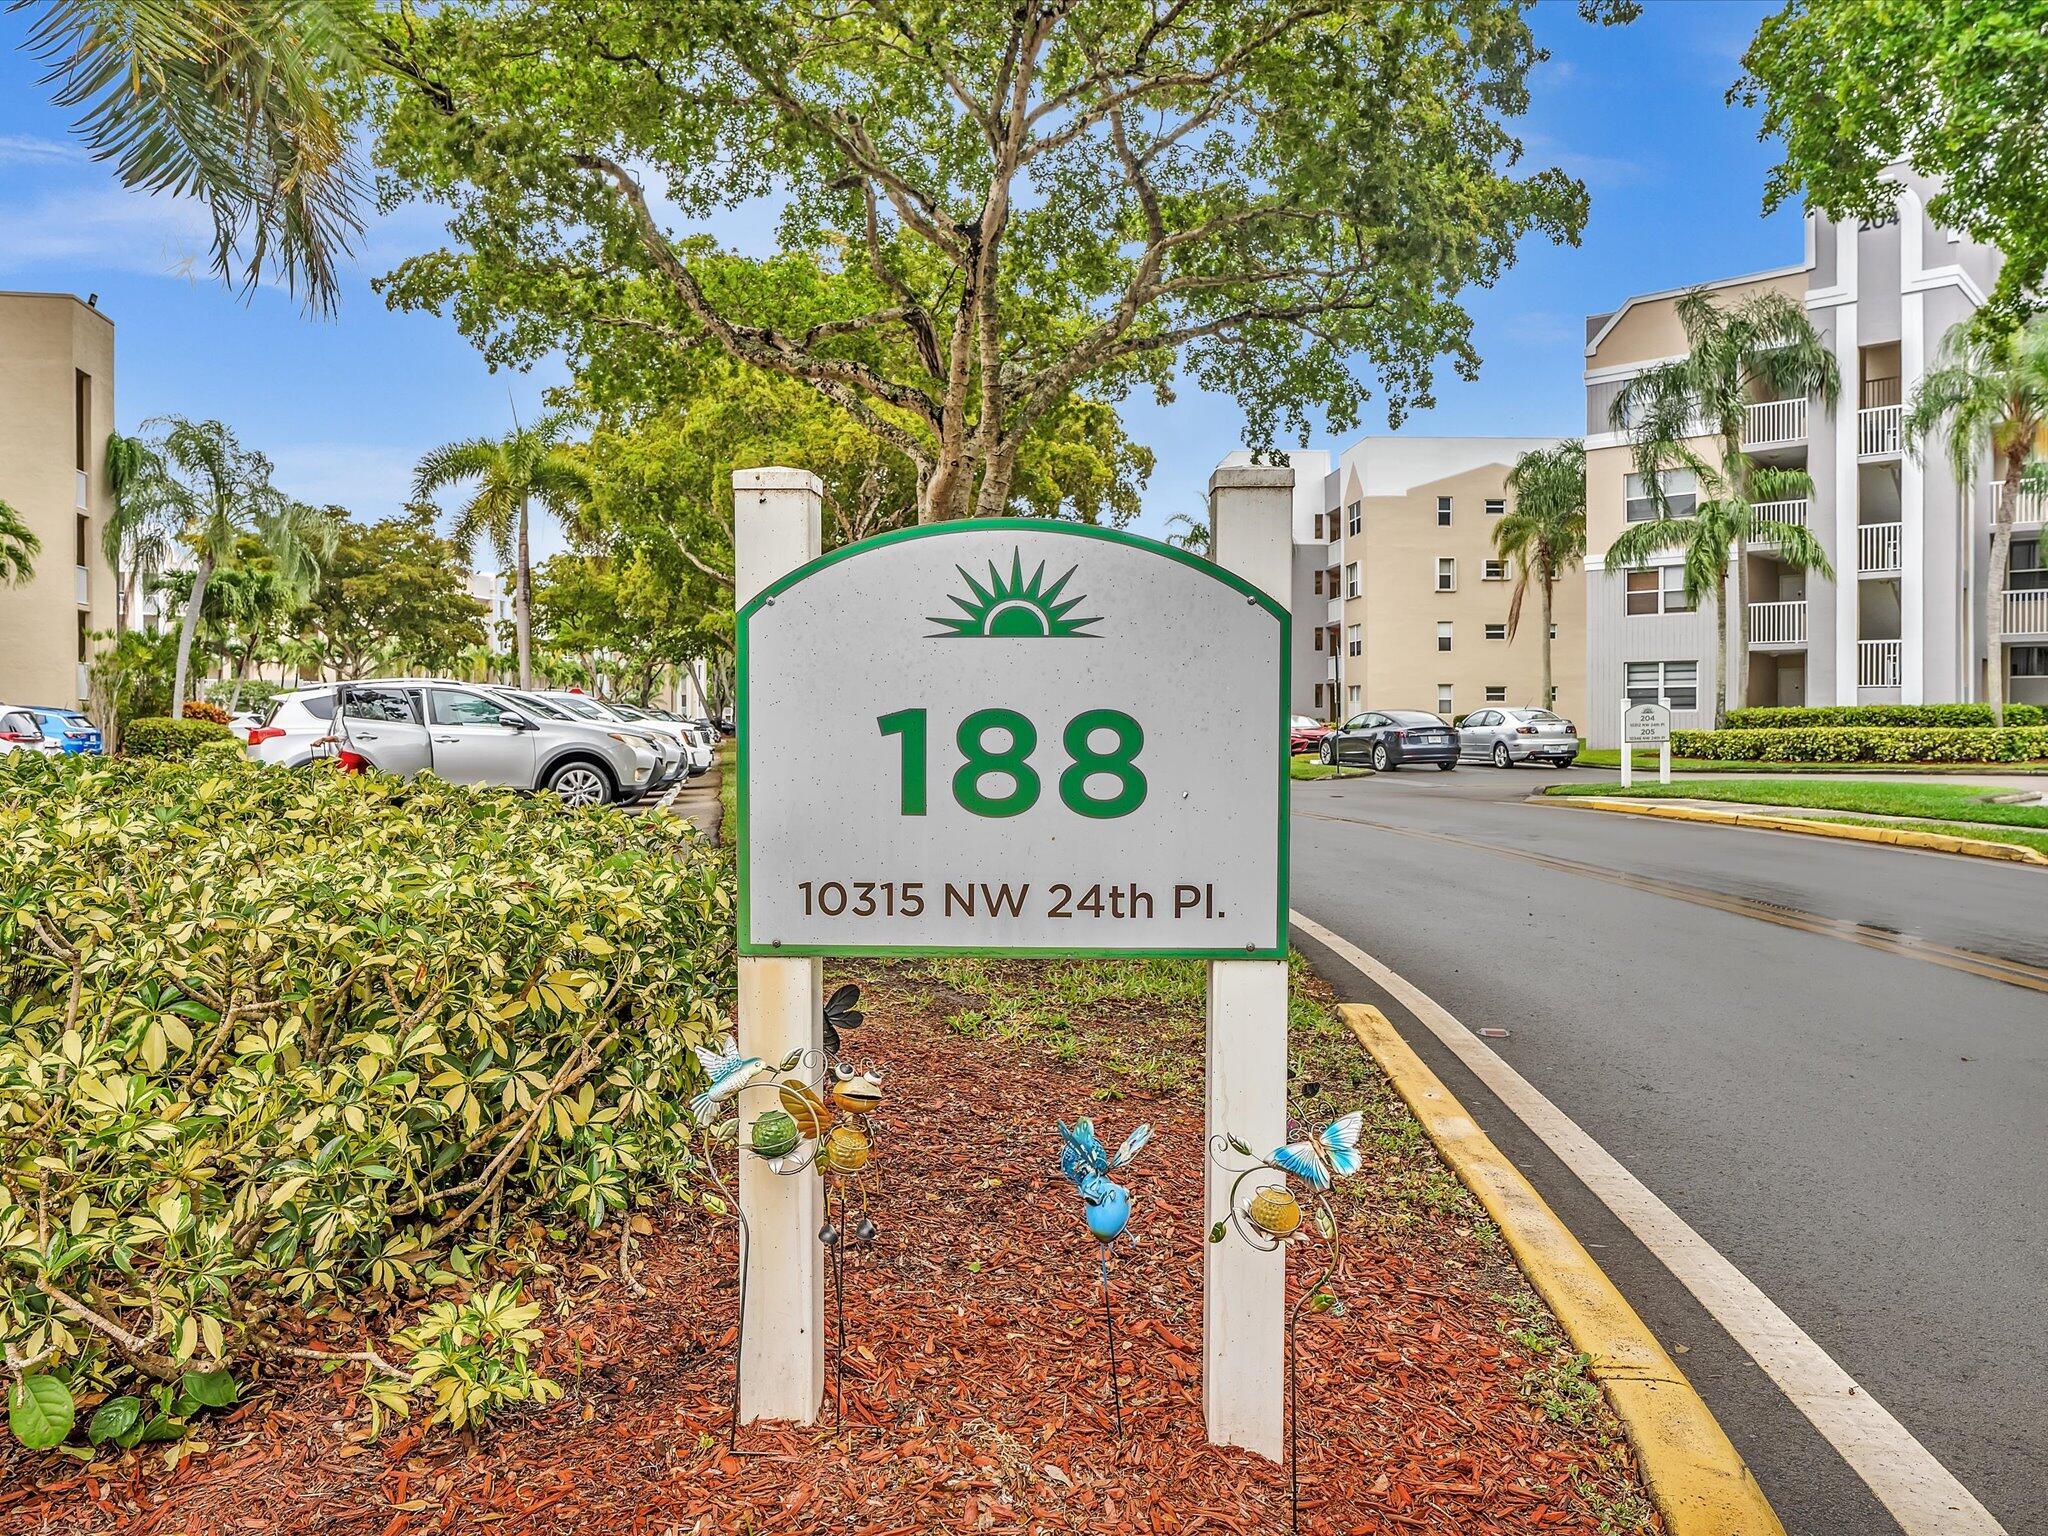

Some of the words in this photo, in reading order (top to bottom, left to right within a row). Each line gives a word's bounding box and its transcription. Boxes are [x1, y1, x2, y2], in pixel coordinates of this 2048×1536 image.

[1857, 210, 1900, 233] 204
[876, 707, 1148, 819] 188
[798, 881, 925, 916] 10315
[944, 883, 1030, 917] NW
[1047, 882, 1154, 918] 24th
[1174, 883, 1226, 919] Pl.
